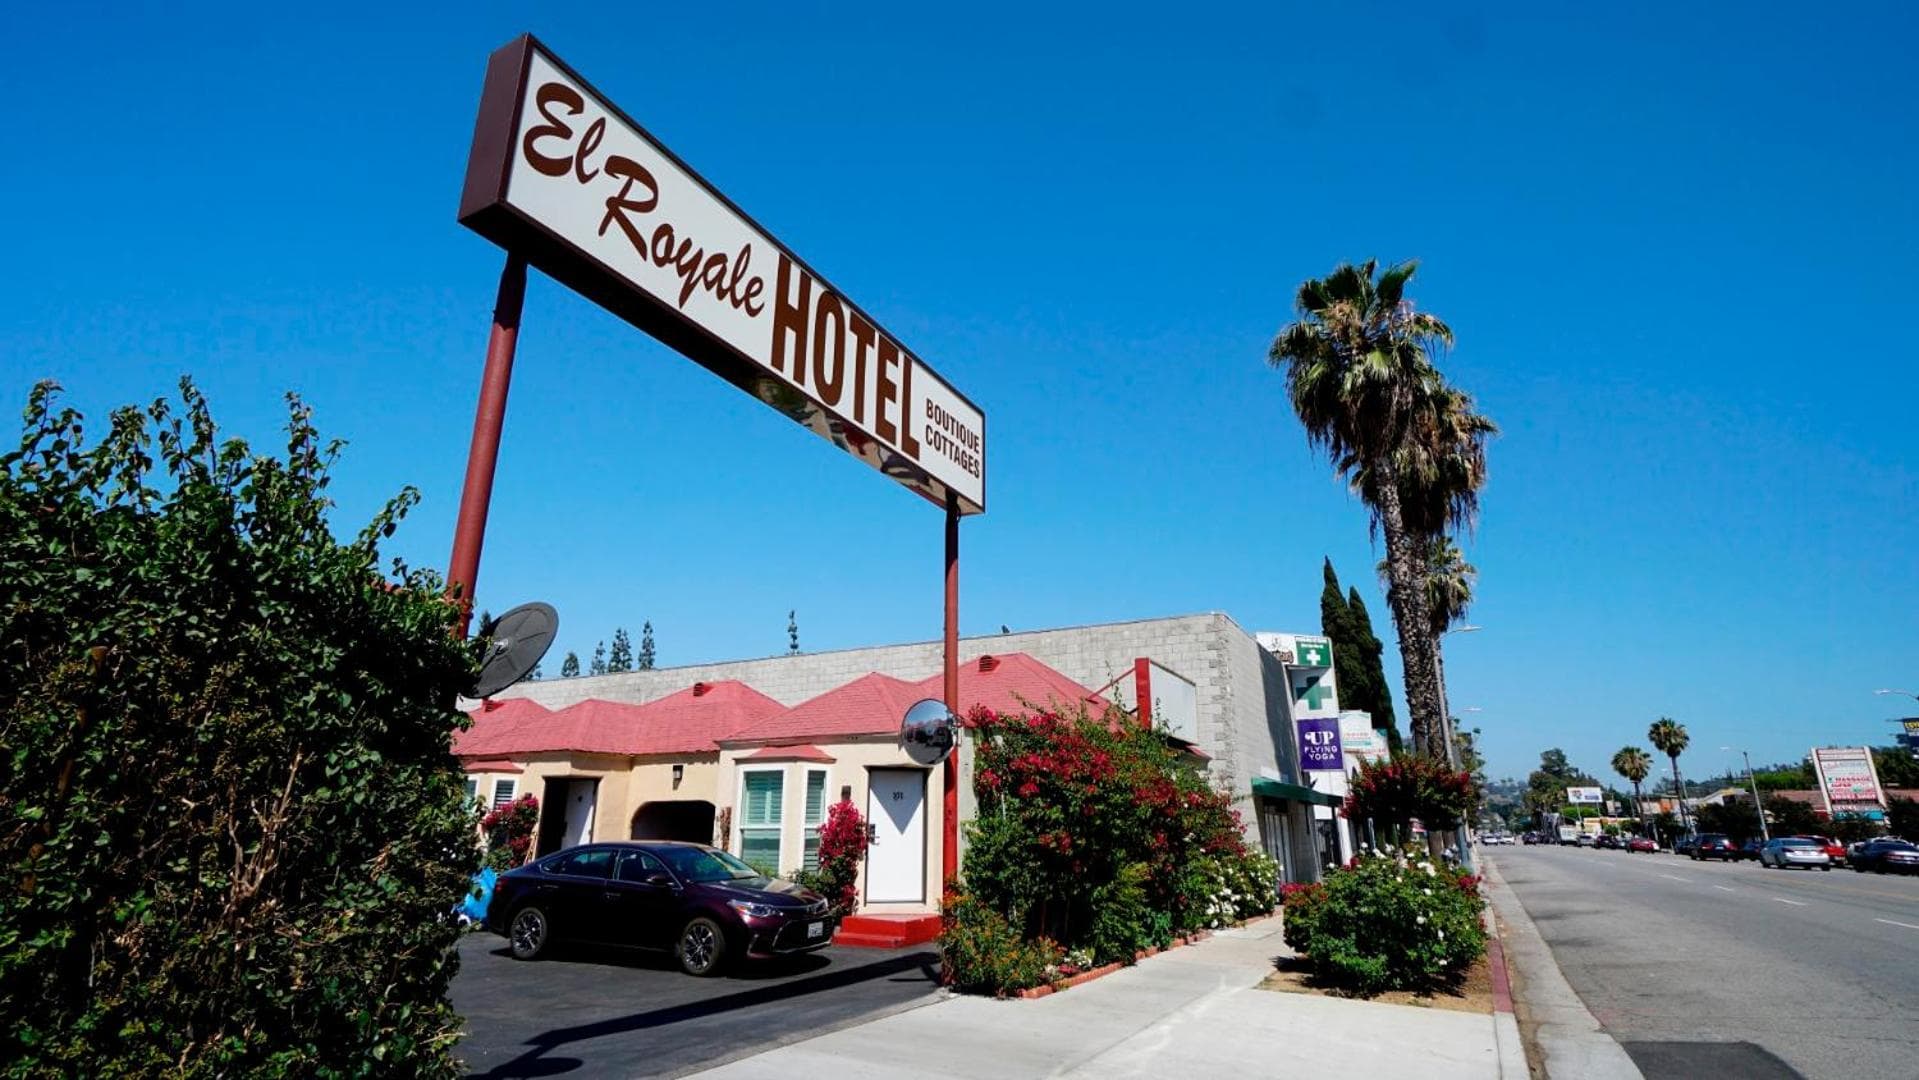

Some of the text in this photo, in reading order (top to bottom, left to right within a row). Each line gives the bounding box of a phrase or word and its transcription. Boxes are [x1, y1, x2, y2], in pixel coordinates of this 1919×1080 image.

[523, 82, 920, 461] El Royale HOTEL
[925, 424, 979, 479] COTTAGES
[926, 397, 979, 455] BOUTIQUE
[1304, 745, 1338, 754] FLYING
